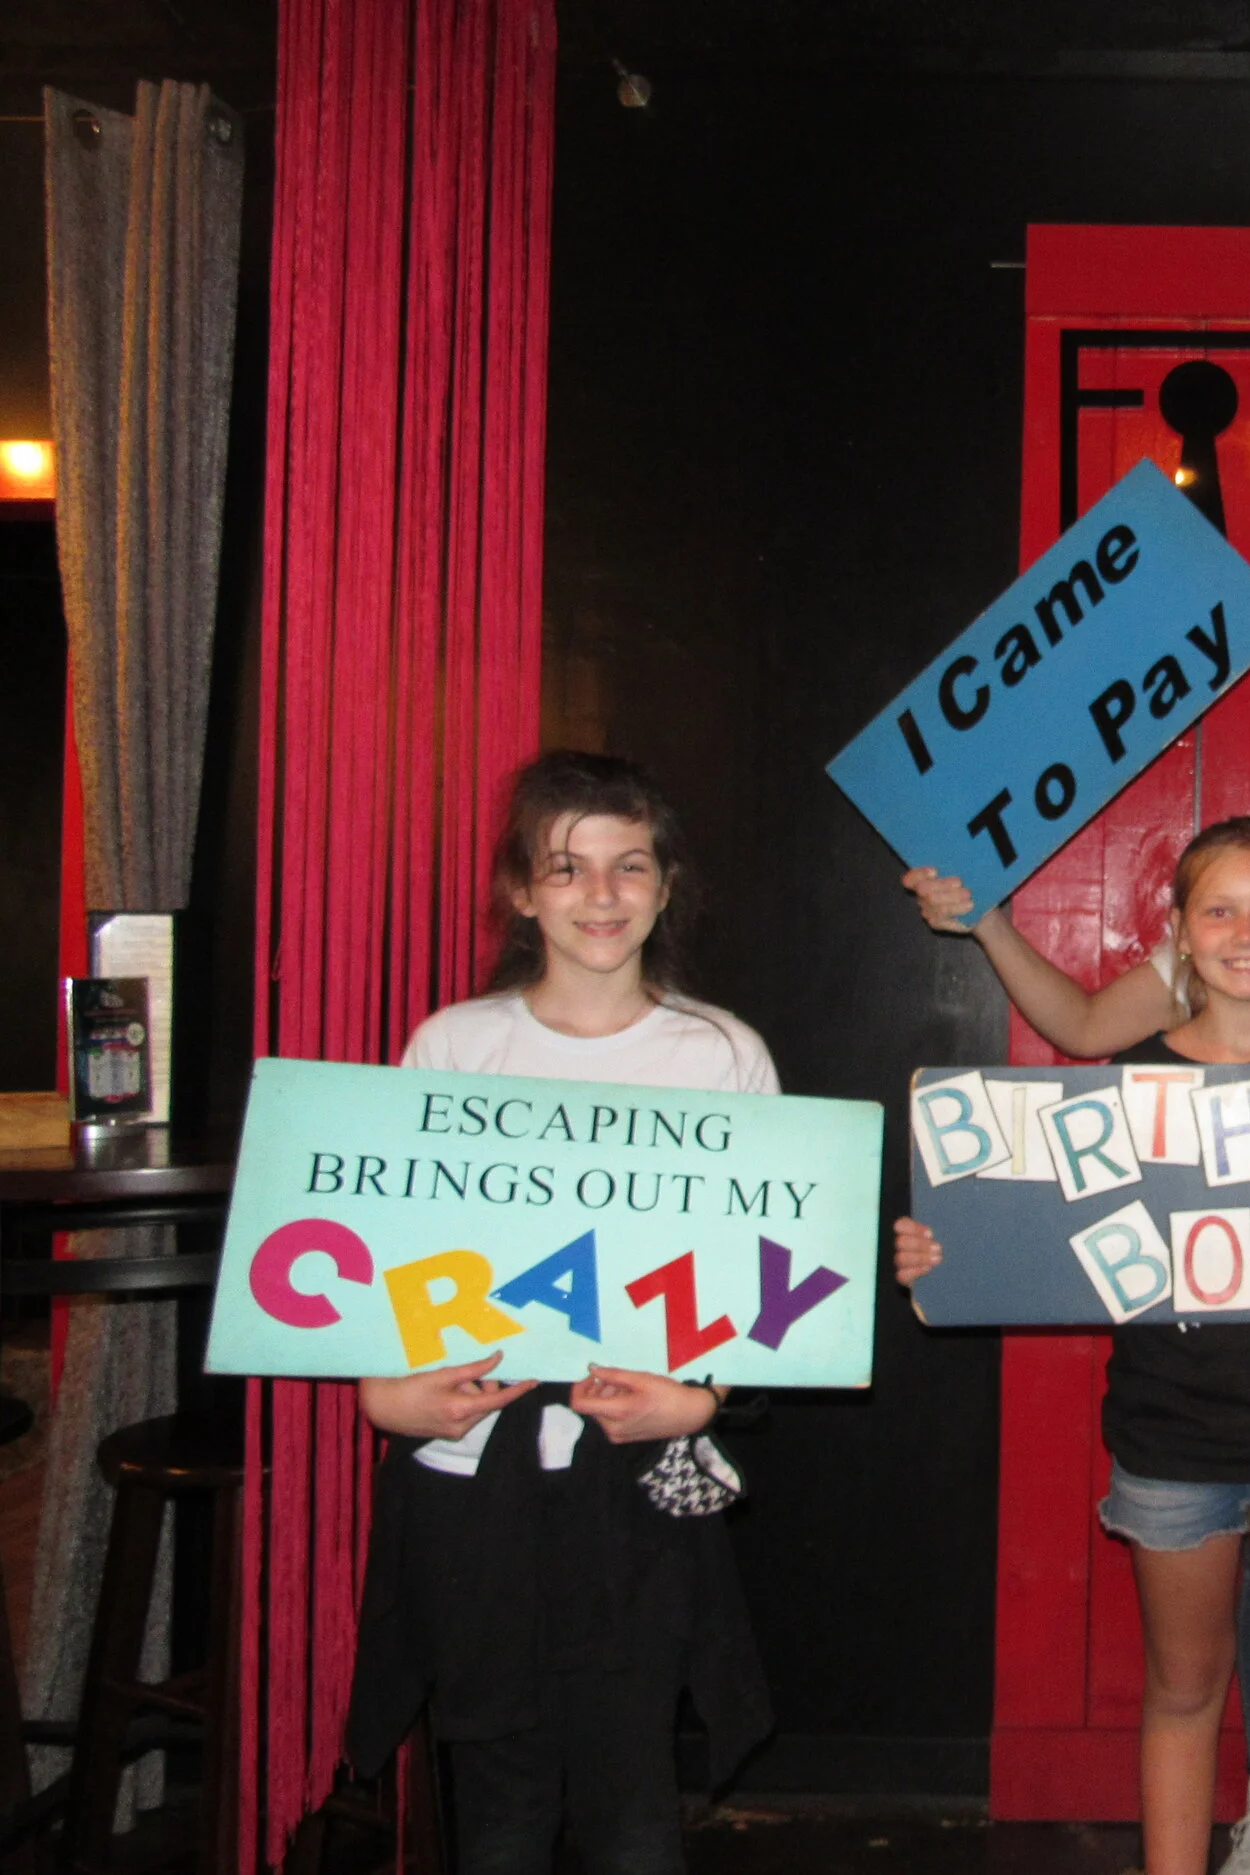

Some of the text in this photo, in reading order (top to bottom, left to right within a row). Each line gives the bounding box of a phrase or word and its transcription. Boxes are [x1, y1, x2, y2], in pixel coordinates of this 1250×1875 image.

[897, 523, 1141, 776] I Came
[966, 601, 1231, 869] To Pay
[305, 1152, 819, 1220] BRINGS OUT MY
[418, 1093, 734, 1152] ESCAPING
[248, 1217, 850, 1373] CRAZY
